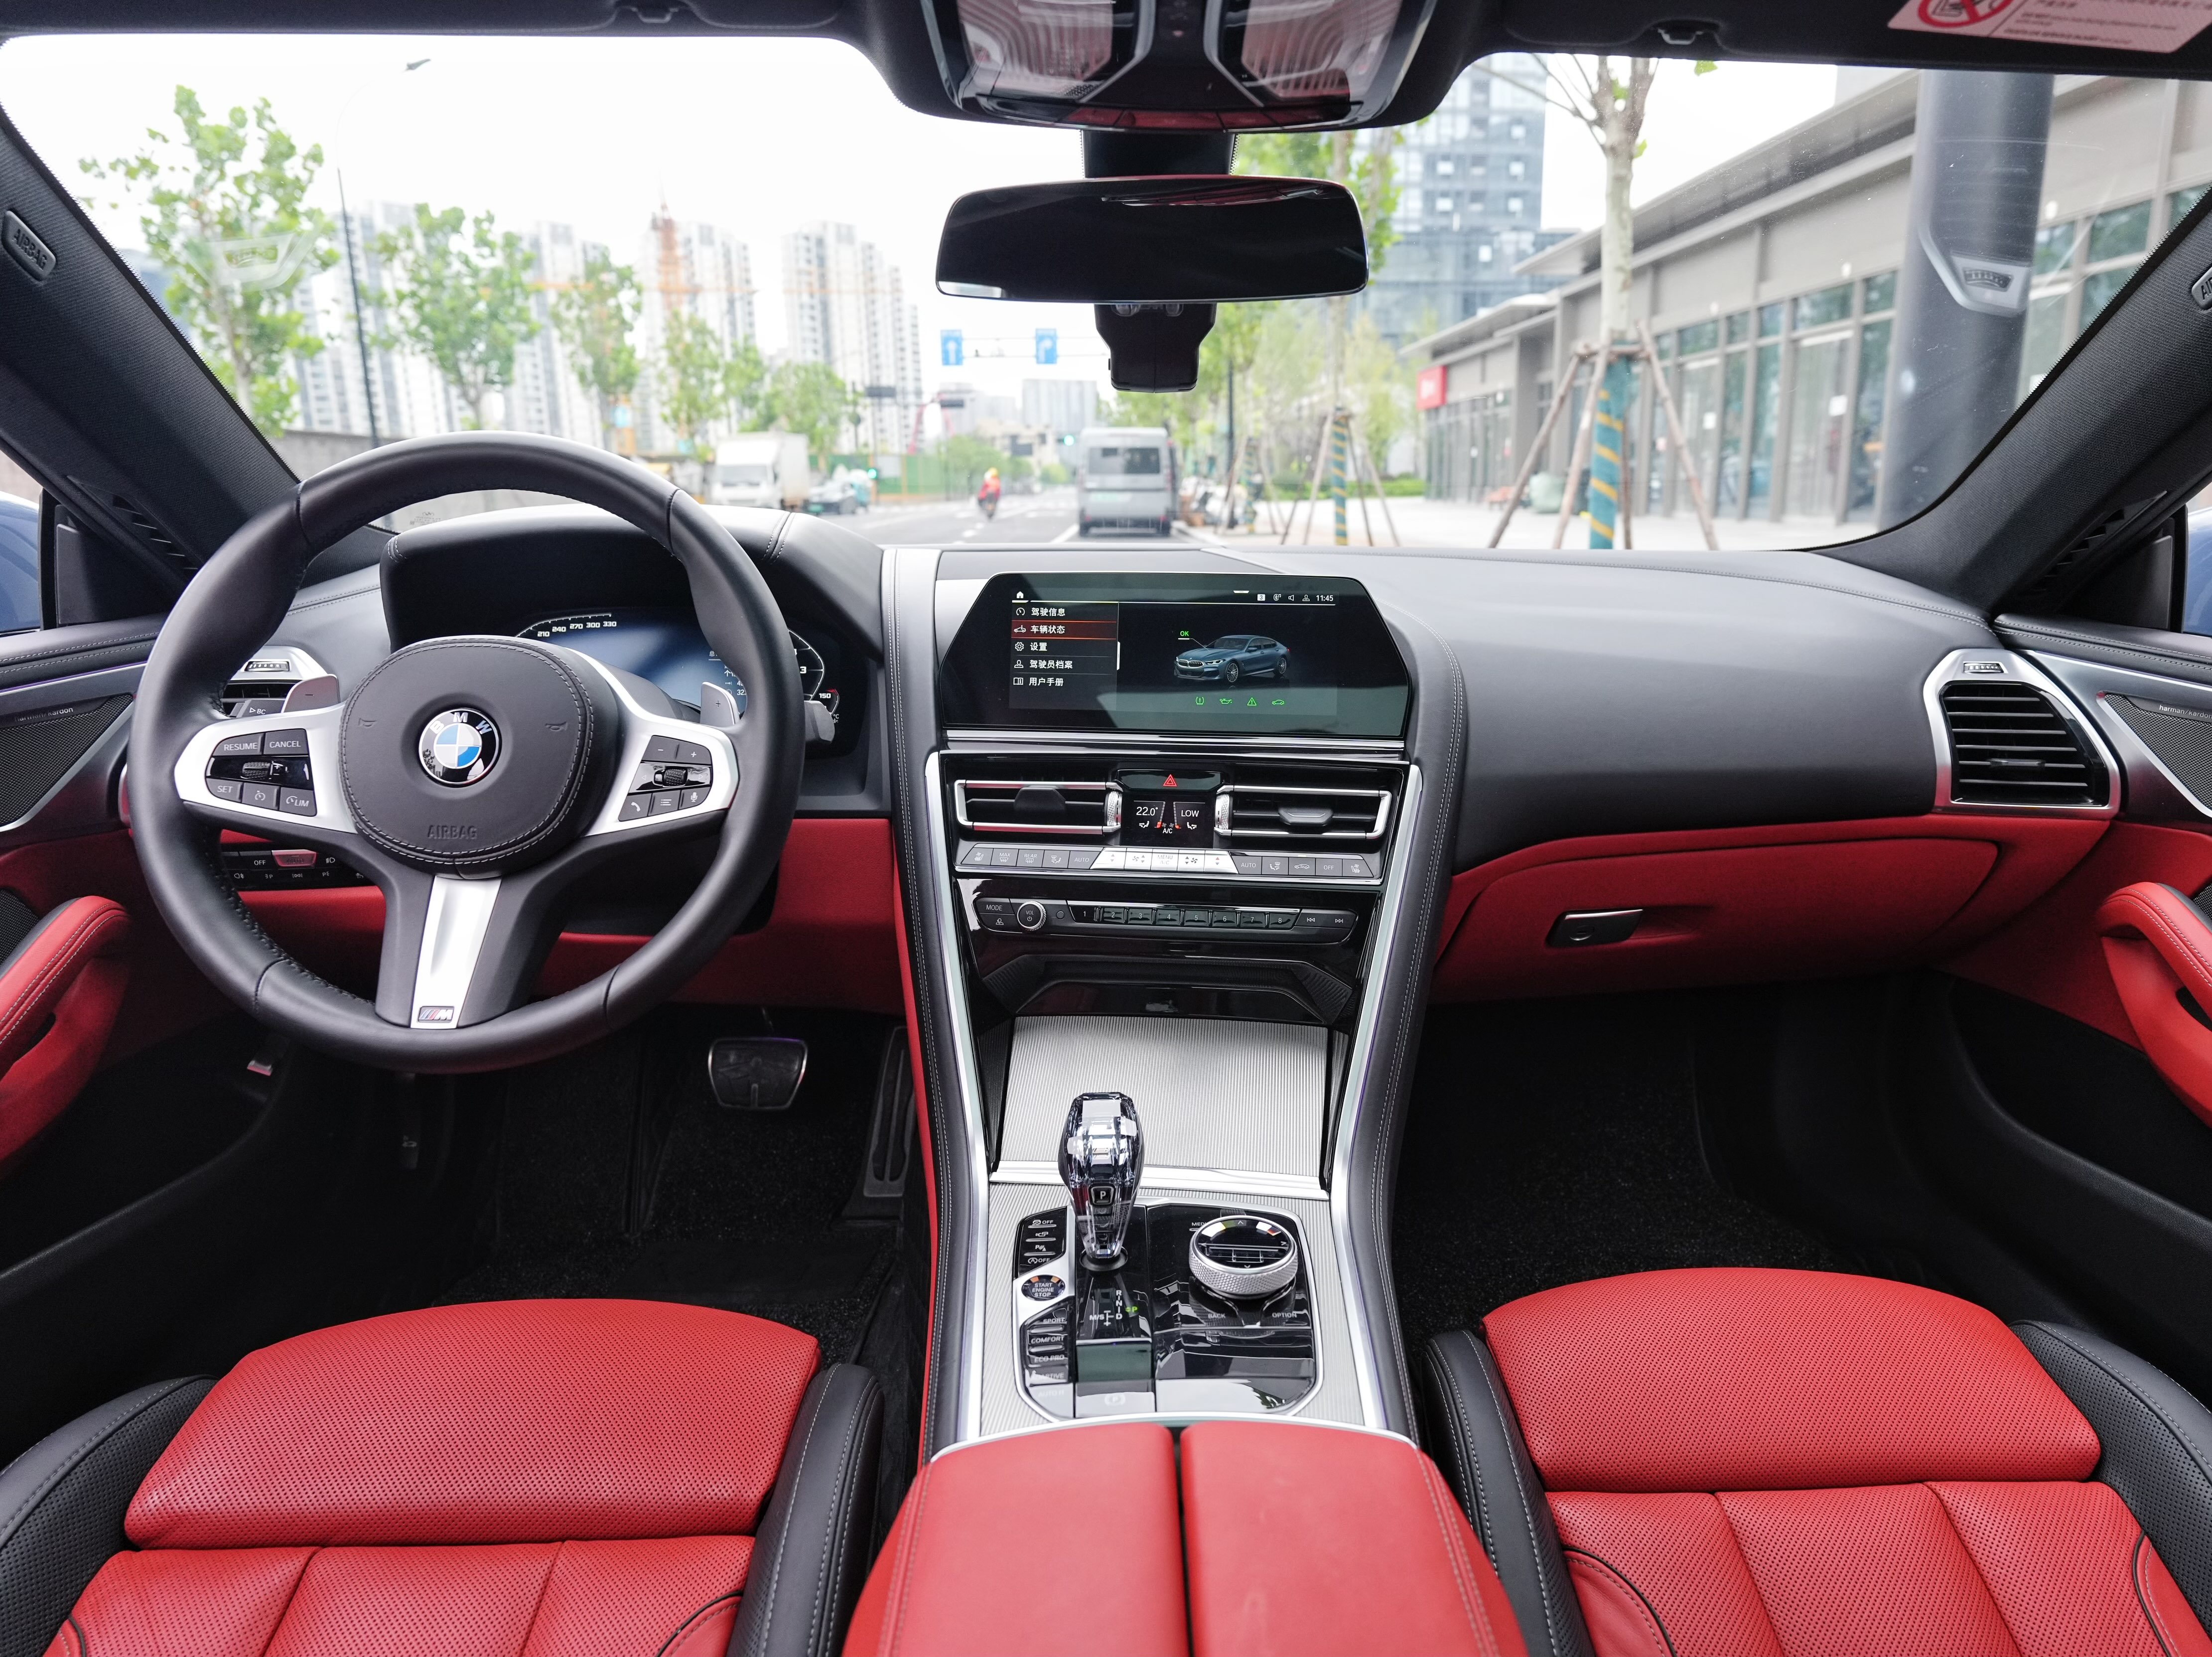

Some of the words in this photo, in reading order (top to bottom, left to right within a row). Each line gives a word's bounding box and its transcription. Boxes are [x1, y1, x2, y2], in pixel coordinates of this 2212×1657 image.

[13, 229, 47, 270] AIRBAG
[1031, 608, 1066, 617] 驾驶信息
[1030, 625, 1065, 634] 车辆状态
[1030, 642, 1047, 651] 设置
[1029, 660, 1073, 669] 驾驶员档案
[1029, 678, 1064, 686] 用户手册
[224, 742, 258, 751] RESUME
[1136, 806, 1158, 816] 22.0°
[427, 825, 477, 839] AIRBAG
[1100, 1191, 1106, 1200] P
